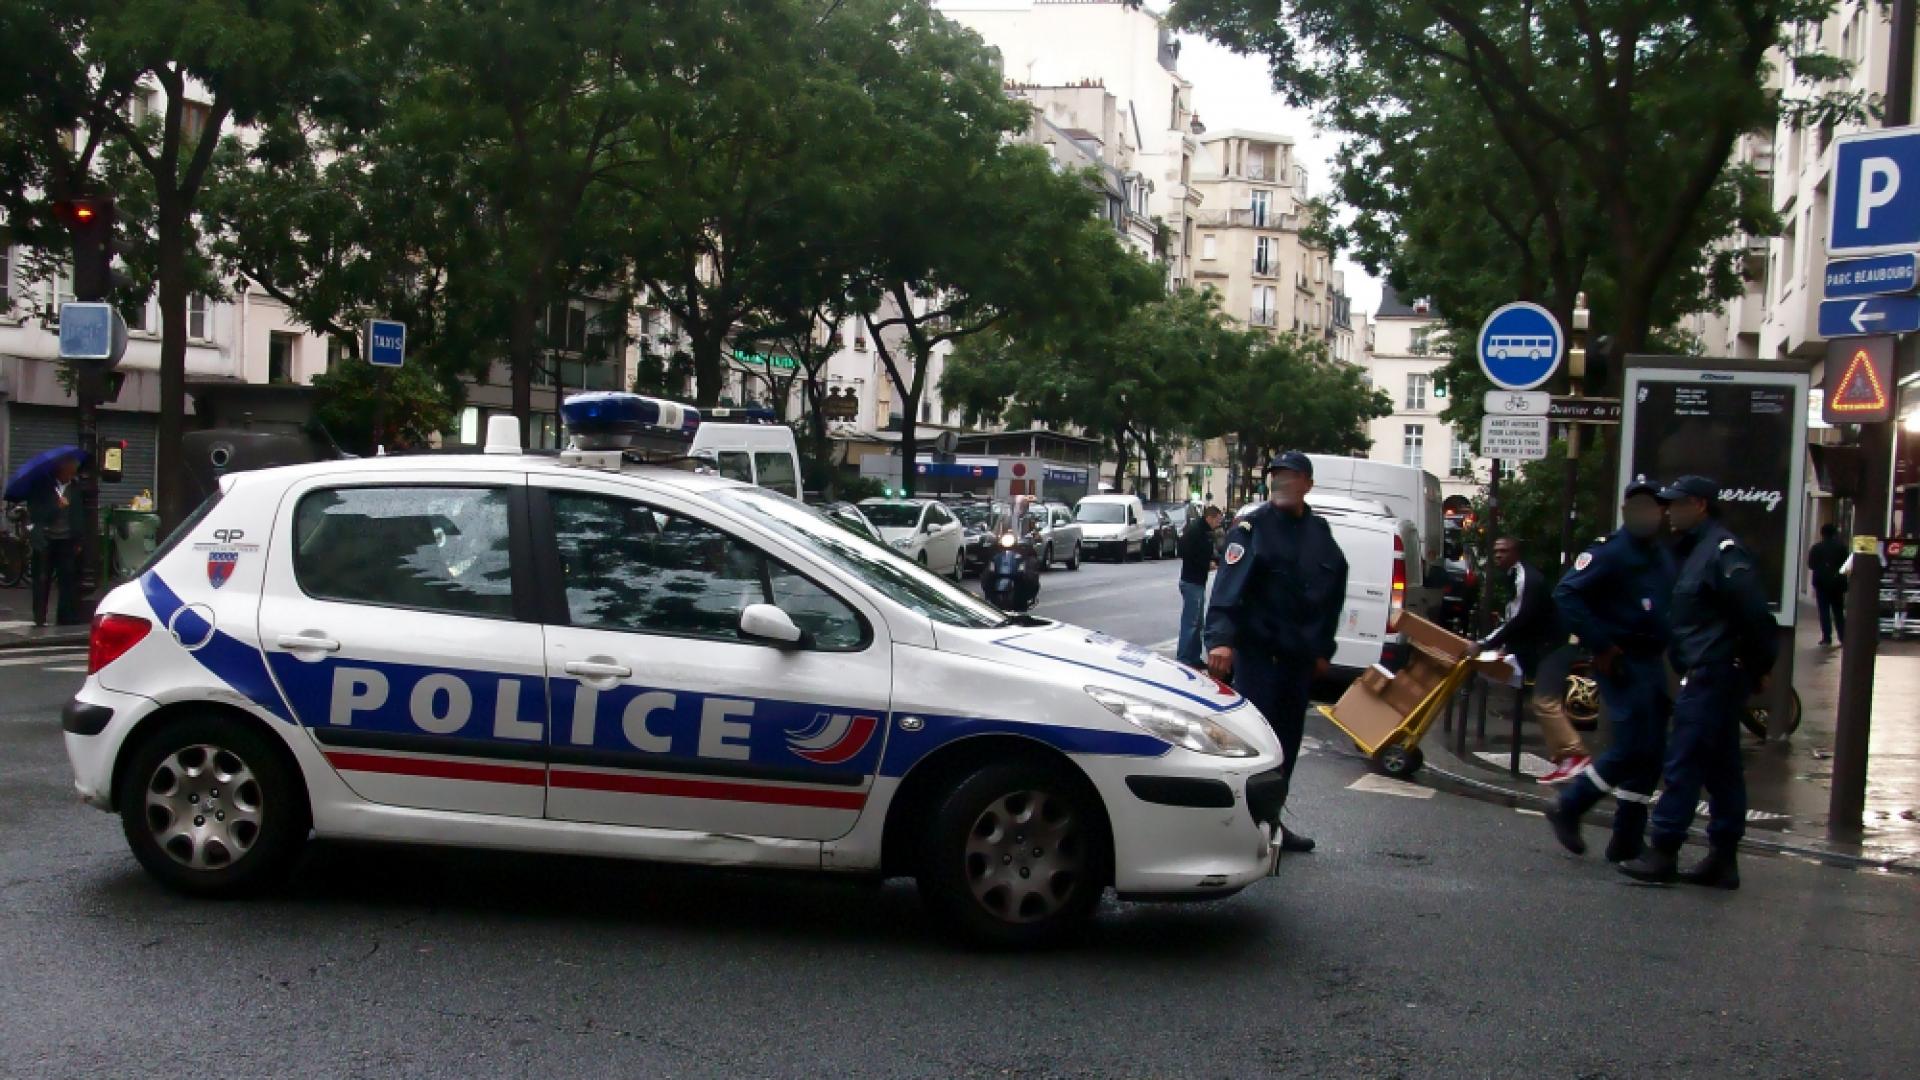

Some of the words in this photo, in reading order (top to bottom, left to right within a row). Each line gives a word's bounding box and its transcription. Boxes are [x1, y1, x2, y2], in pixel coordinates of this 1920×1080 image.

[1856, 157, 1900, 229] P
[1827, 272, 1851, 285] PARC
[1855, 266, 1912, 283] BEAUBOURG
[329, 666, 755, 760] POLICE
